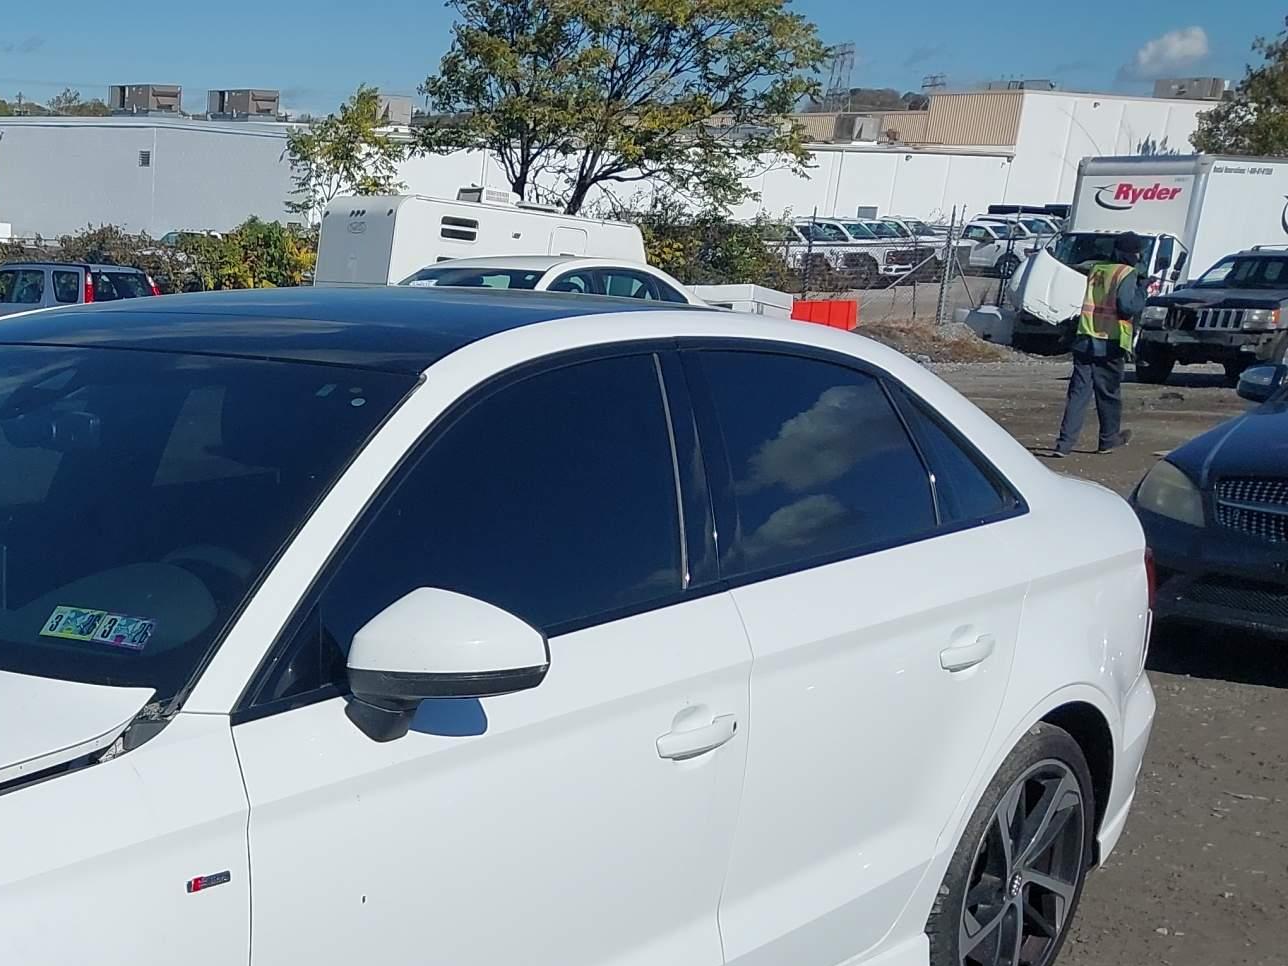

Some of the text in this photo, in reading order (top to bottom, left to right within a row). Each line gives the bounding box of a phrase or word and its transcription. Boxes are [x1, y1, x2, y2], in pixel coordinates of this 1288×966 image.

[1114, 183, 1183, 204] Ryder
[49, 614, 63, 631] 3
[101, 618, 118, 638] 3
